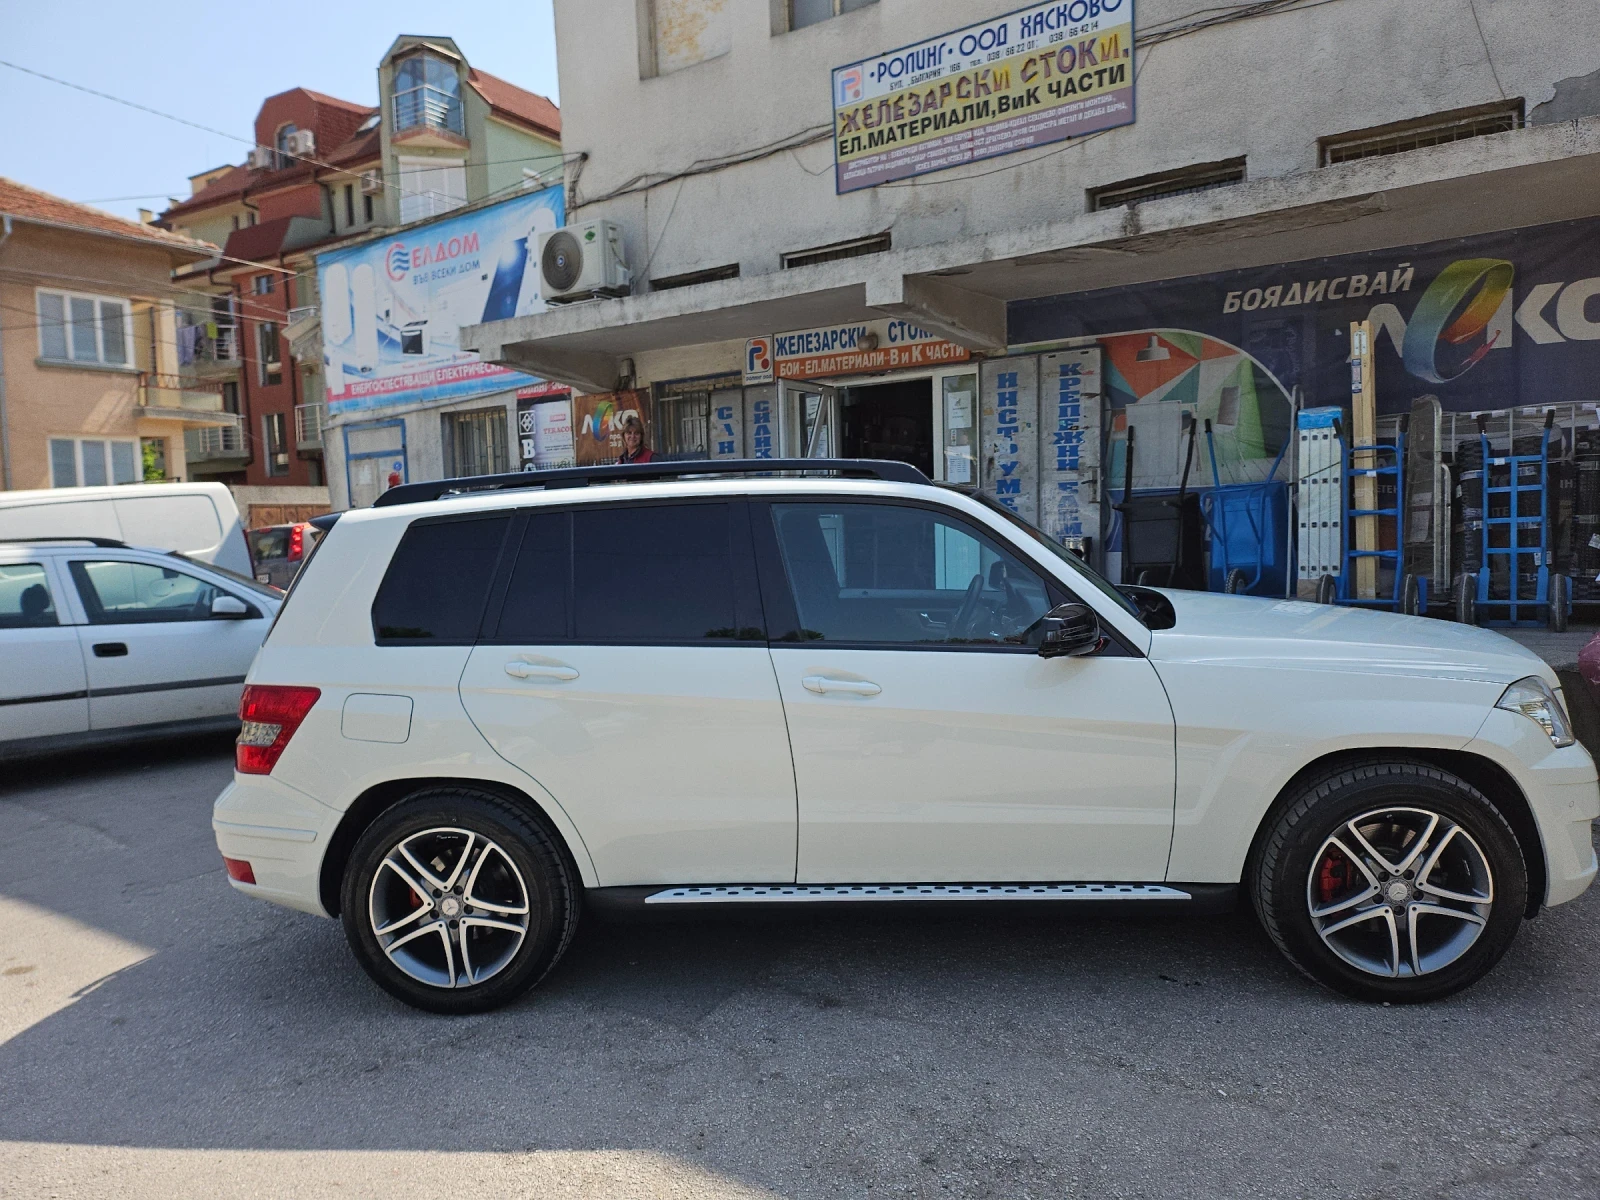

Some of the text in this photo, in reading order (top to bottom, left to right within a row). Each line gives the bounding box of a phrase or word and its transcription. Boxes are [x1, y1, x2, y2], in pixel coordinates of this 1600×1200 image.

[960, 23, 1007, 56] ООД
[1020, 0, 1122, 39] ХАСКОВО
[1006, 46, 1015, 56] 66
[1015, 43, 1025, 54] 22
[1069, 27, 1078, 38] 66
[1080, 23, 1089, 34] 42
[1091, 20, 1099, 31] 14
[1048, 64, 1125, 99] ЧАСТИ
[838, 65, 1010, 137] ЖЕЛЕЗАРСКИ
[412, 230, 479, 269] ЕЛДОМ
[413, 259, 480, 285] ВЪВ ВСЕКИ ДОМ
[1223, 263, 1415, 314] БОЯДИСВАЙ
[776, 326, 867, 357] ЖЕЛЕЗАРСКИ
[926, 343, 965, 360] ЧАСТИ
[1053, 363, 1085, 471] КРЕПЕЖНИ
